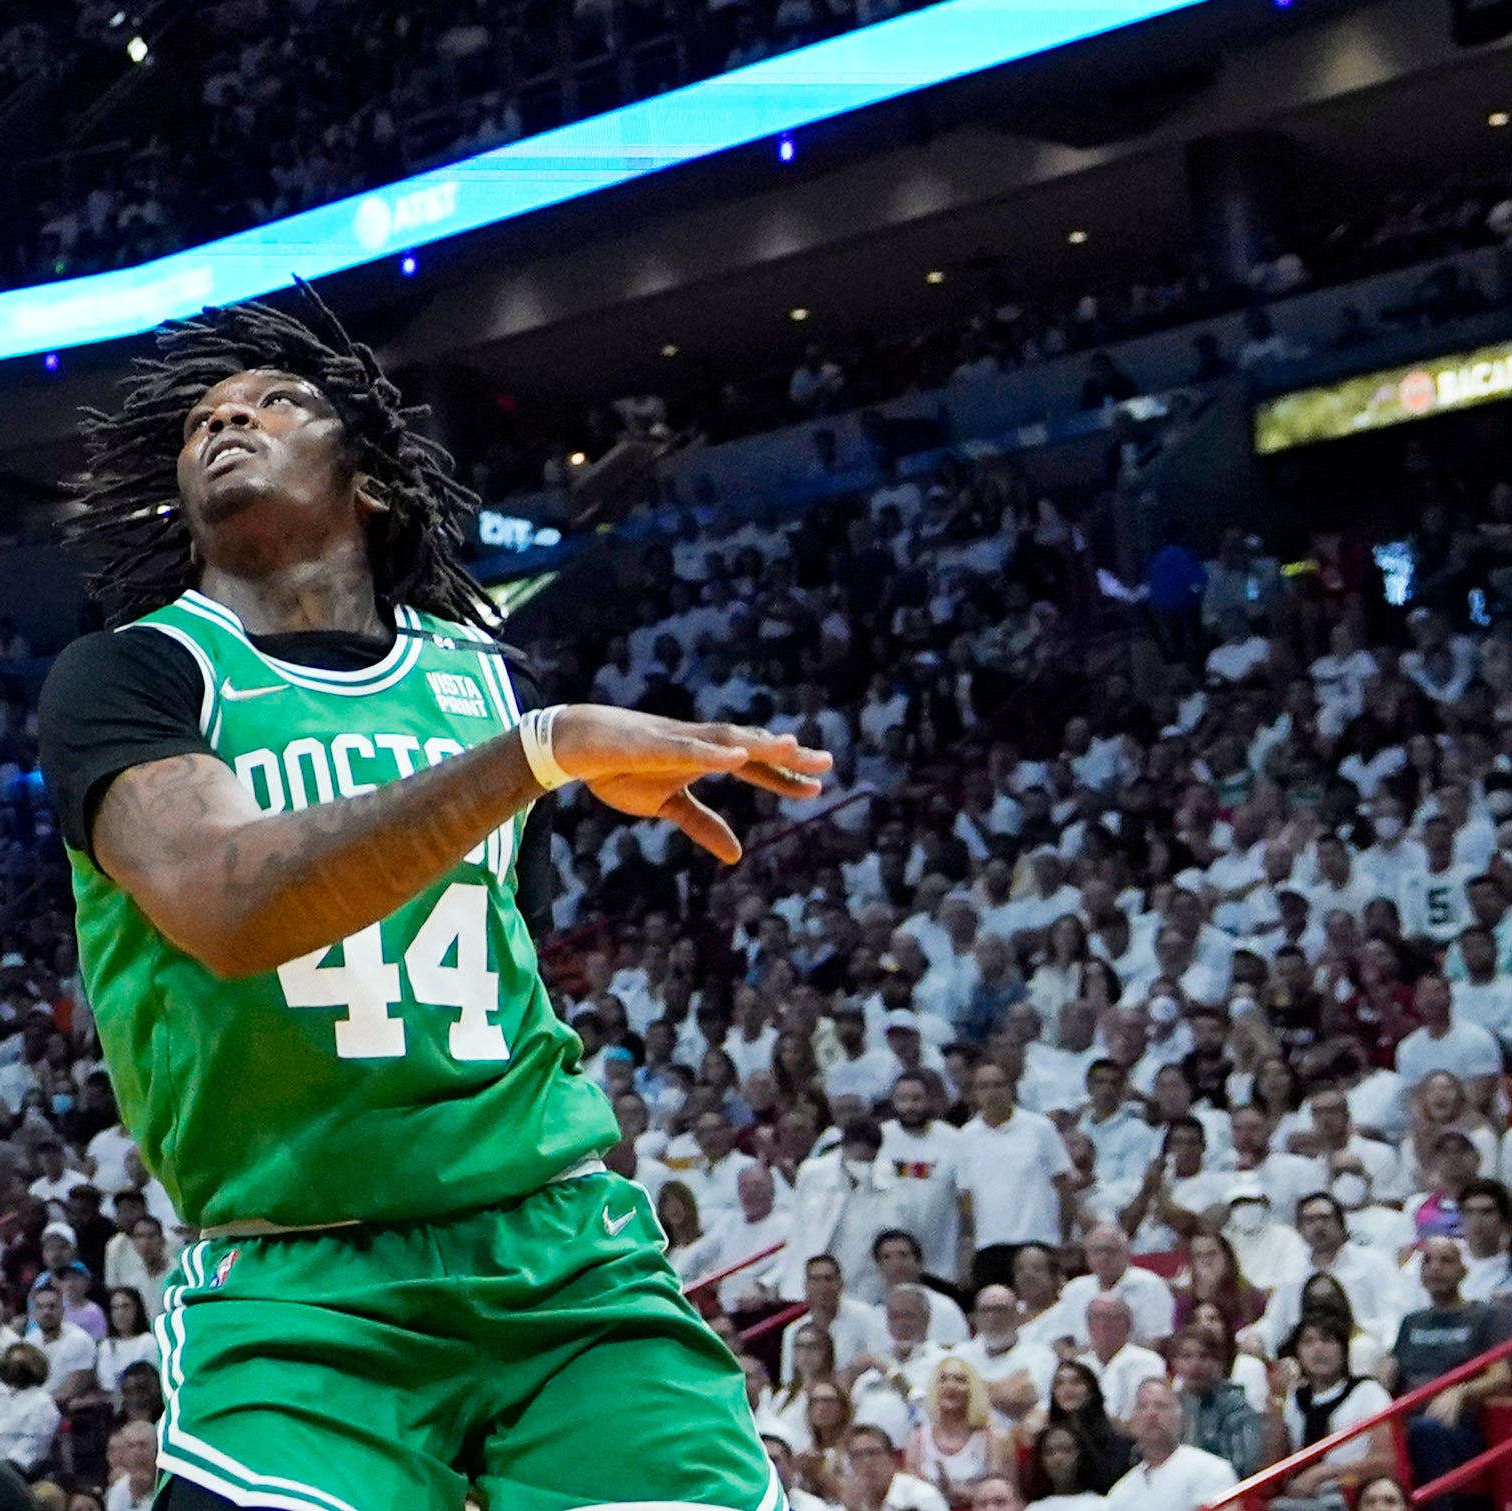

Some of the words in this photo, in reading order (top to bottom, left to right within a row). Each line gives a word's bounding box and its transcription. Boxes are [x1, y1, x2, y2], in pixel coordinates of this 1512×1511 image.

[425, 671, 483, 700] VISTA
[435, 694, 489, 718] PRINT
[276, 882, 511, 1061] 44
